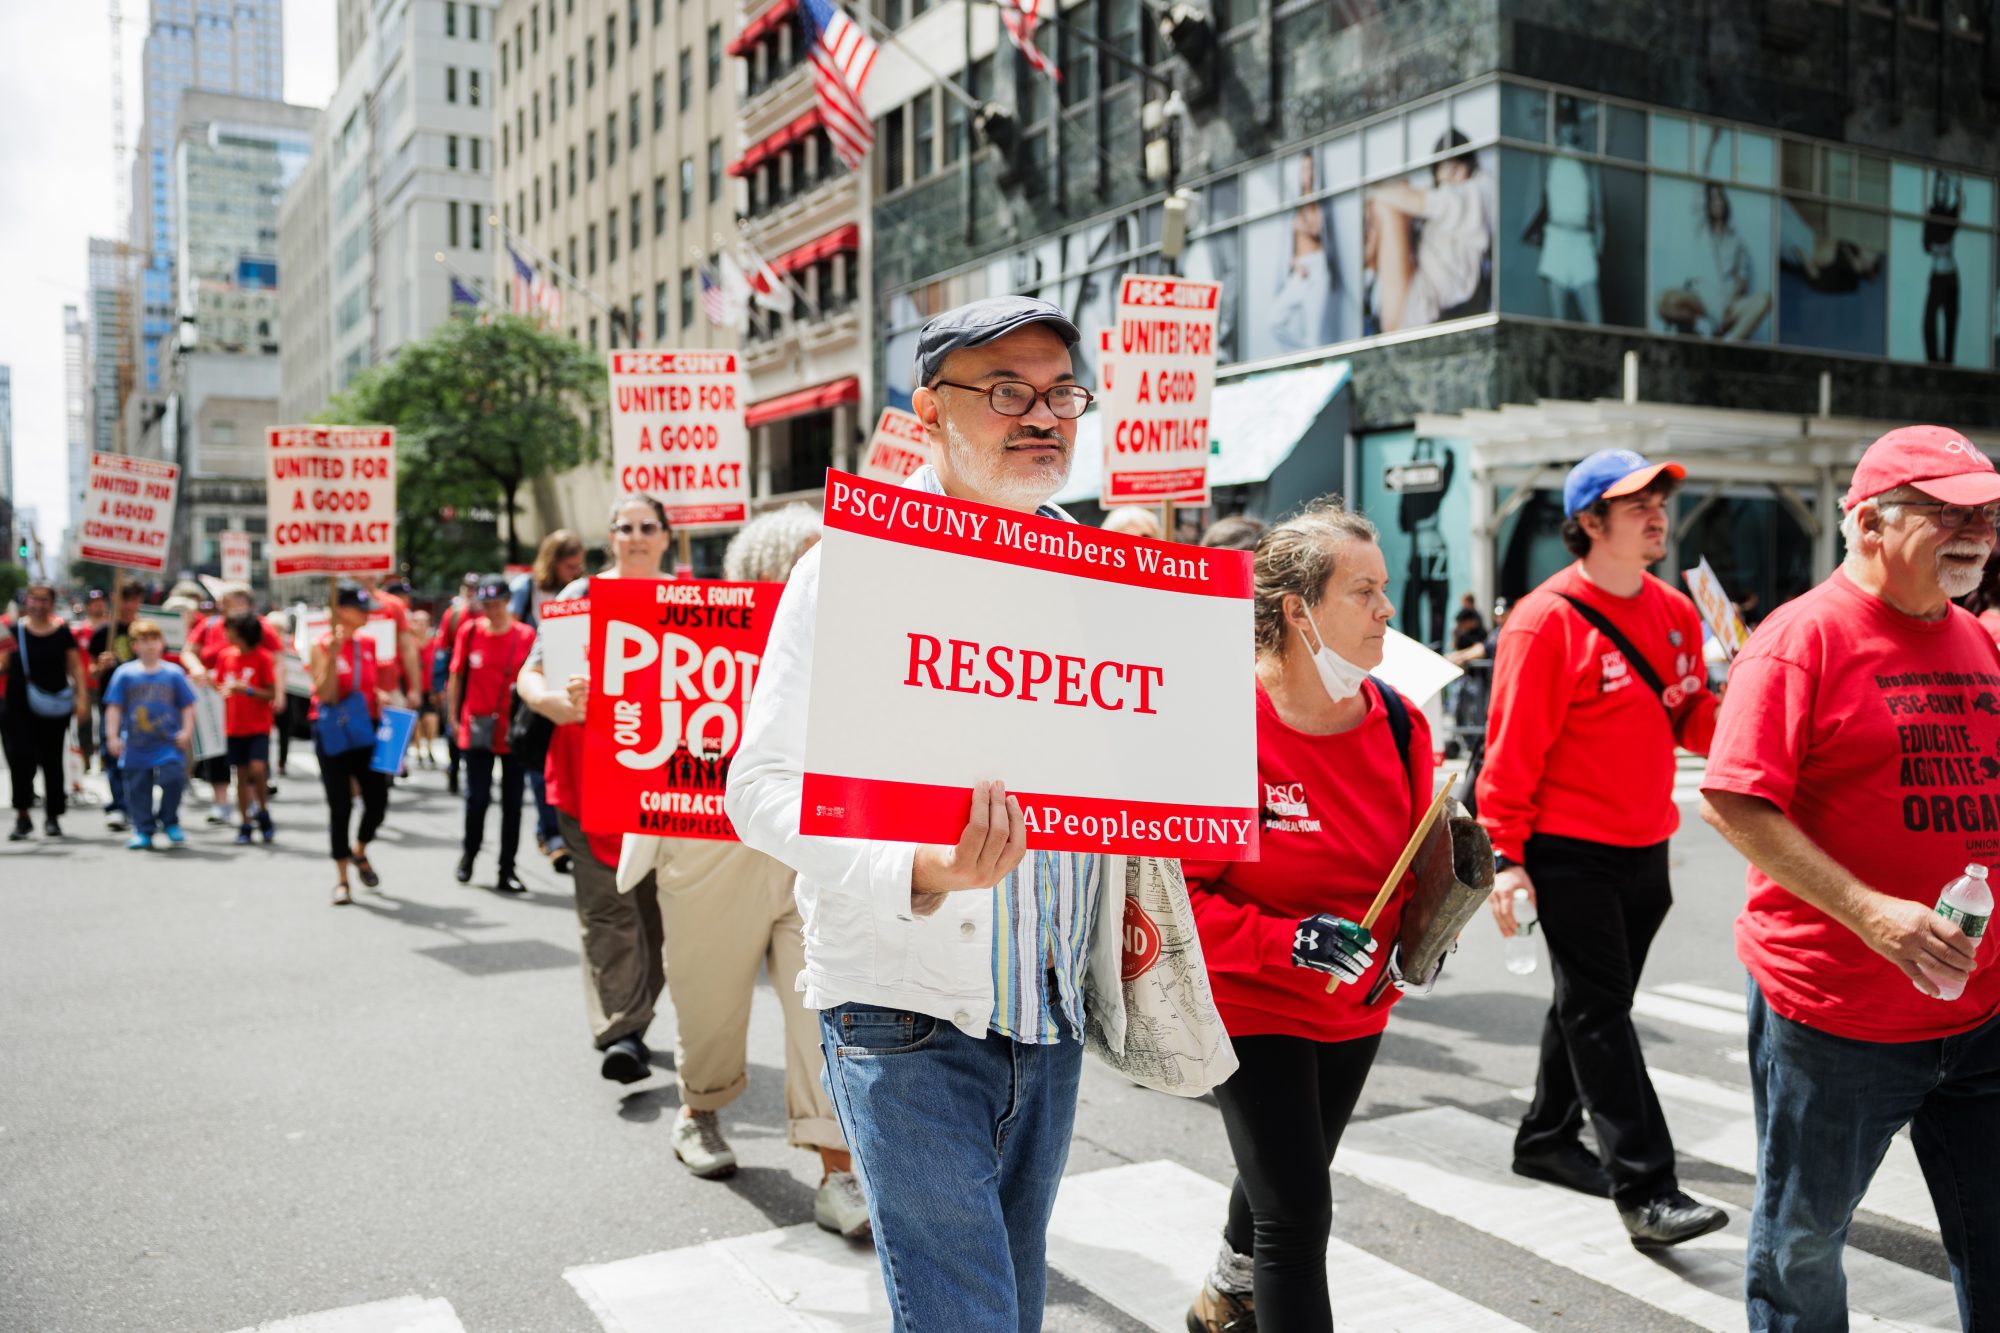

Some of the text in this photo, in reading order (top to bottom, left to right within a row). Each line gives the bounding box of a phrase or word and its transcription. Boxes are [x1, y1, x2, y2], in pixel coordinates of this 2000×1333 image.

[1185, 322, 1212, 356] FOR
[620, 354, 728, 374] PSC-CUNY
[617, 385, 736, 414] UNITED FOR
[1137, 371, 1151, 404] A
[639, 425, 718, 452] A GOOD
[274, 457, 388, 479] UNITED FOR
[621, 462, 742, 493] CONTRACT
[292, 490, 370, 512] A GOOD
[275, 523, 390, 546] CONTRACT
[831, 481, 1210, 582] PSC/CUNY Members Want
[543, 599, 591, 616] PSC/CU
[658, 606, 753, 629] JUSTICE
[603, 620, 761, 703] PROT
[903, 632, 1164, 715] RESPECT
[1874, 672, 1932, 689] Brooklyn
[1885, 693, 1966, 716] PSC-CUNY
[613, 699, 642, 746] OUR
[615, 700, 746, 770] JO
[1897, 723, 1981, 754] EDUCATE.
[1900, 757, 1985, 788] AGITATE.
[640, 791, 726, 816] CONTRACT
[1264, 783, 1306, 805] PSC
[1903, 794, 2000, 834] ORGA
[1966, 838, 1999, 850] UNION
